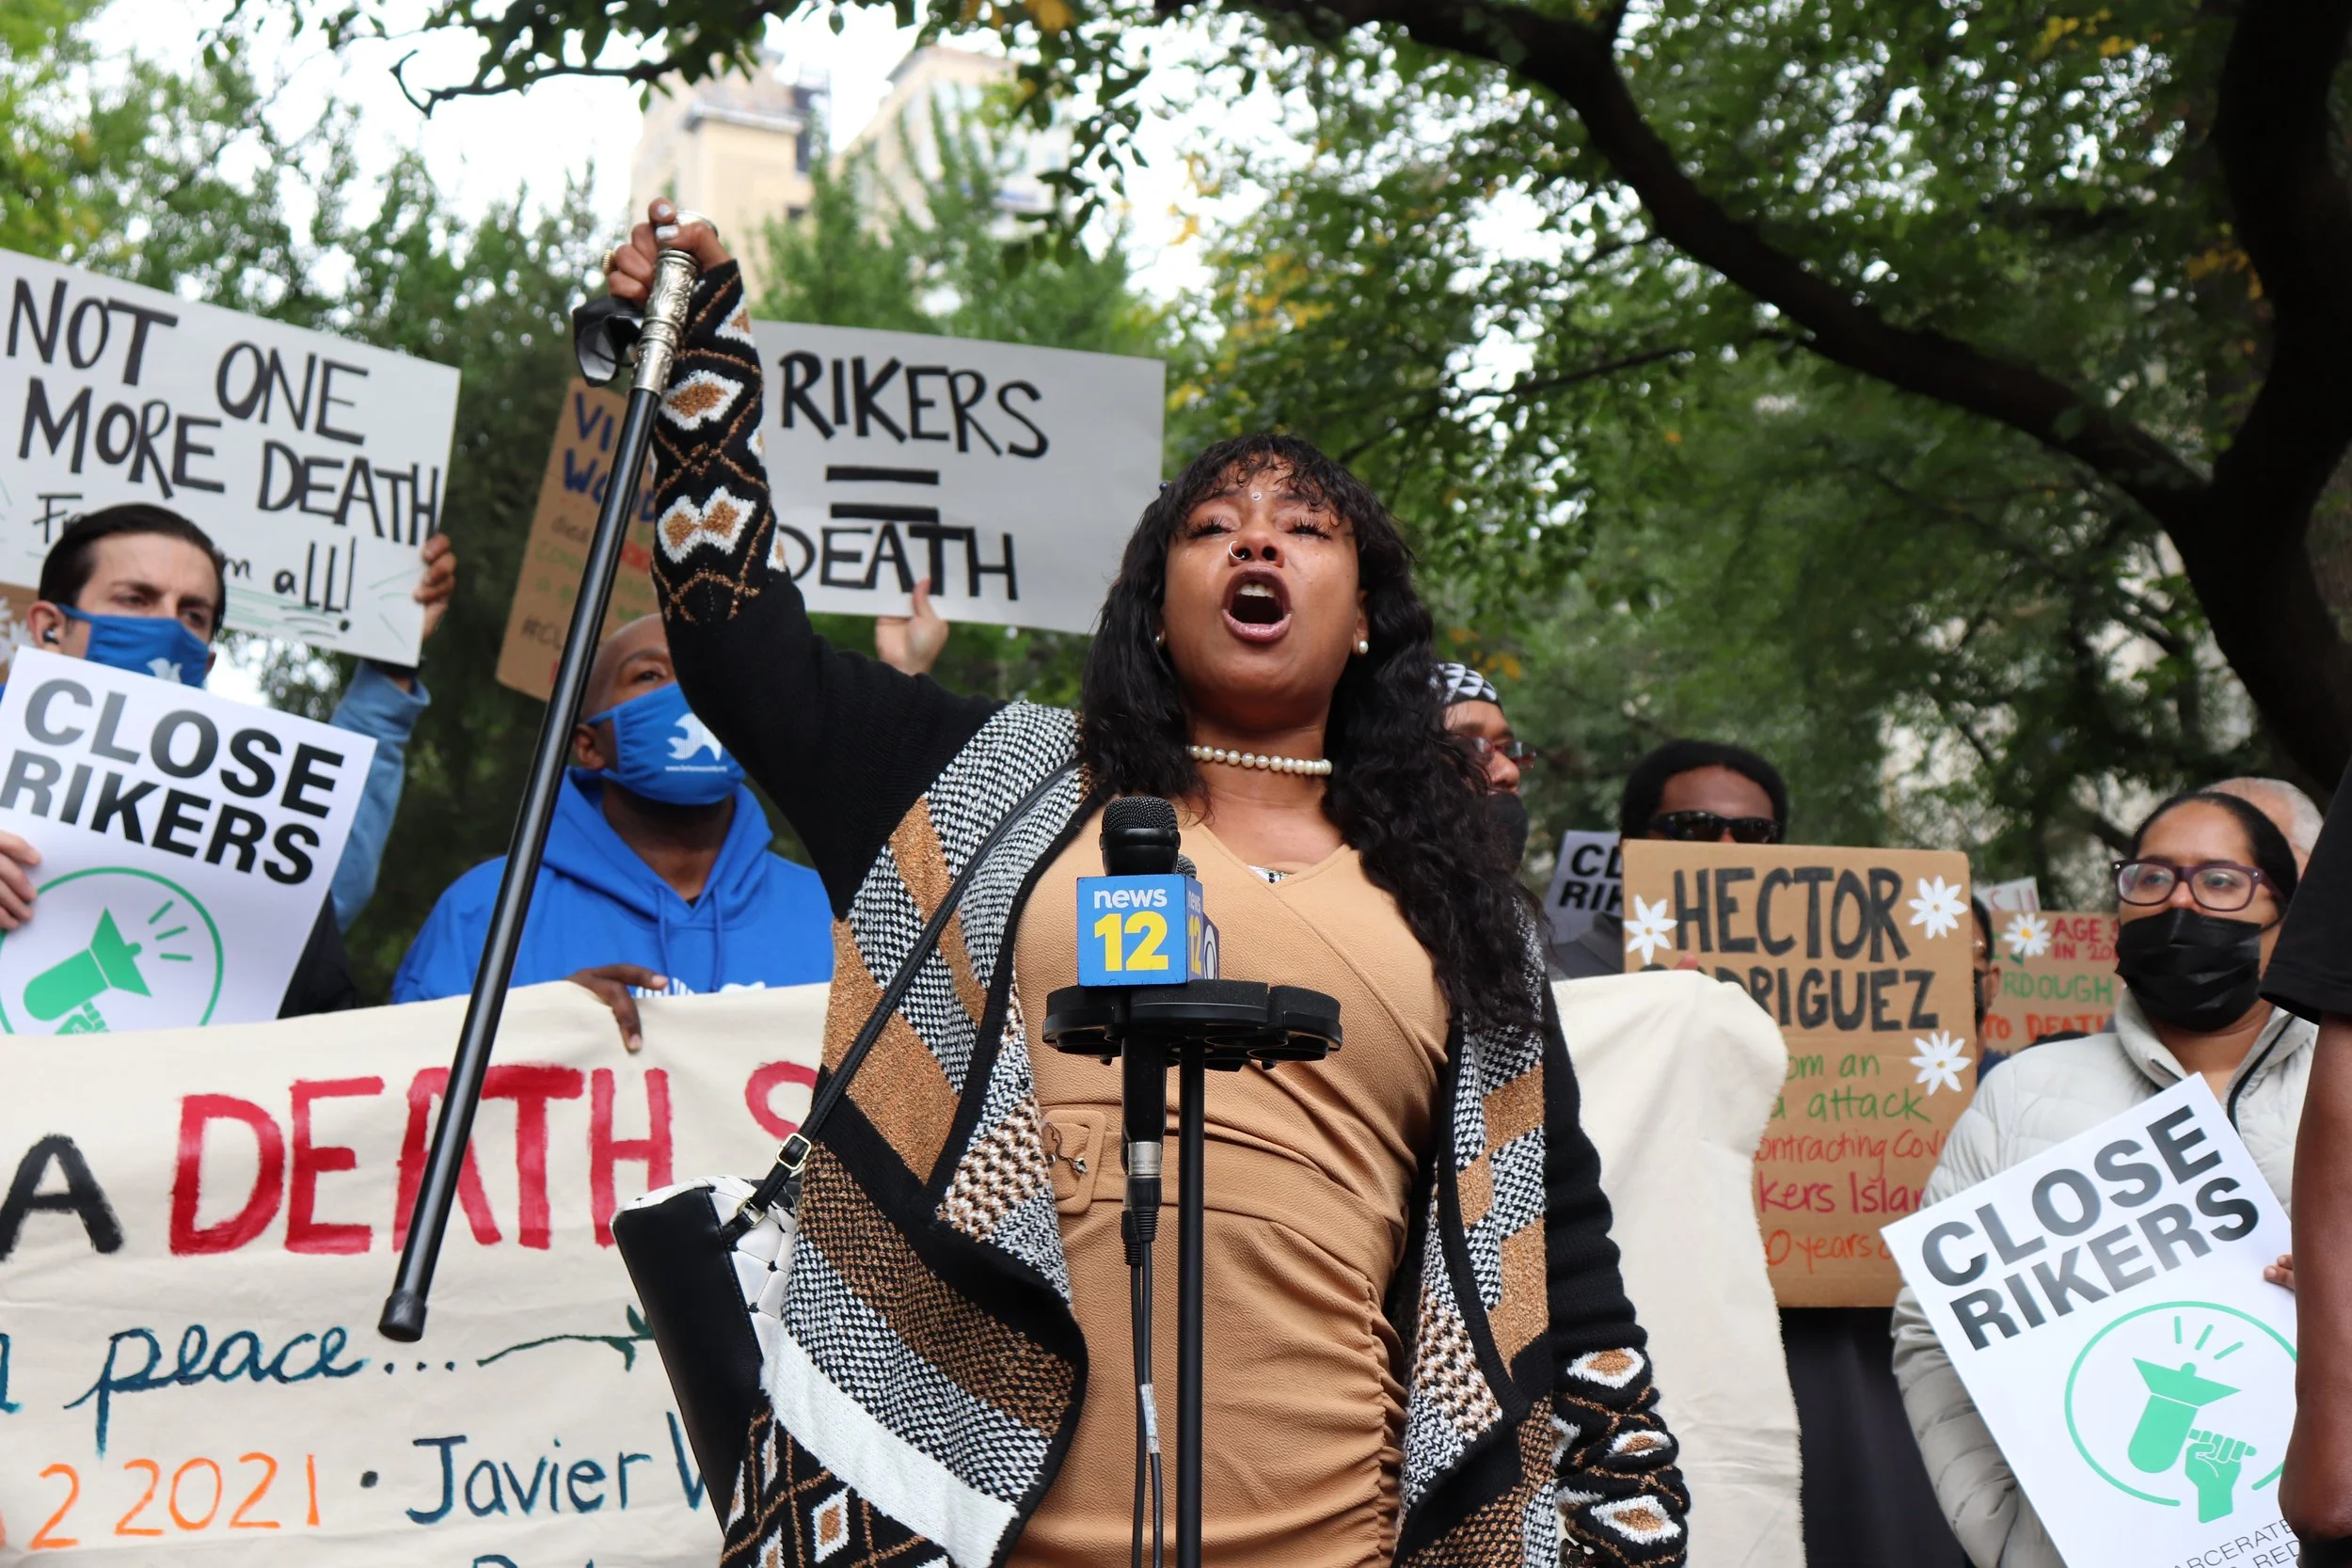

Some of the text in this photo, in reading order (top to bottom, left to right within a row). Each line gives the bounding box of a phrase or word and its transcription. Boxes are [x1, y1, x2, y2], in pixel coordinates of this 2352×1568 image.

[8, 277, 369, 446] NOT ONE
[779, 351, 1048, 459] RIKERS
[19, 376, 439, 546] MORE DEATH
[779, 523, 1019, 601] DEATH
[24, 678, 344, 819] CLOSE
[0, 749, 320, 885] RIKERS
[1571, 844, 1623, 879] CL
[1093, 888, 1168, 910] news
[1675, 866, 1911, 961] HECTOR
[2051, 918, 2103, 942] AGE
[1094, 911, 1169, 972] 12
[1189, 914, 1202, 975] 12
[2051, 942, 2076, 960] IN
[2001, 970, 2115, 1005] RDOUGH
[1786, 1053, 1880, 1081] om an
[1807, 1085, 1932, 1123] attack
[0, 1133, 124, 1263] A
[169, 1064, 675, 1255] DEATH
[1754, 1129, 1887, 1182] ontracting
[1757, 1170, 1836, 1214] kers
[1922, 1104, 2222, 1287] CLOSE
[1795, 1233, 1873, 1275] years
[1949, 1177, 2260, 1352] RIKERS
[114, 1452, 321, 1536] 2021
[405, 1433, 652, 1526] Javier
